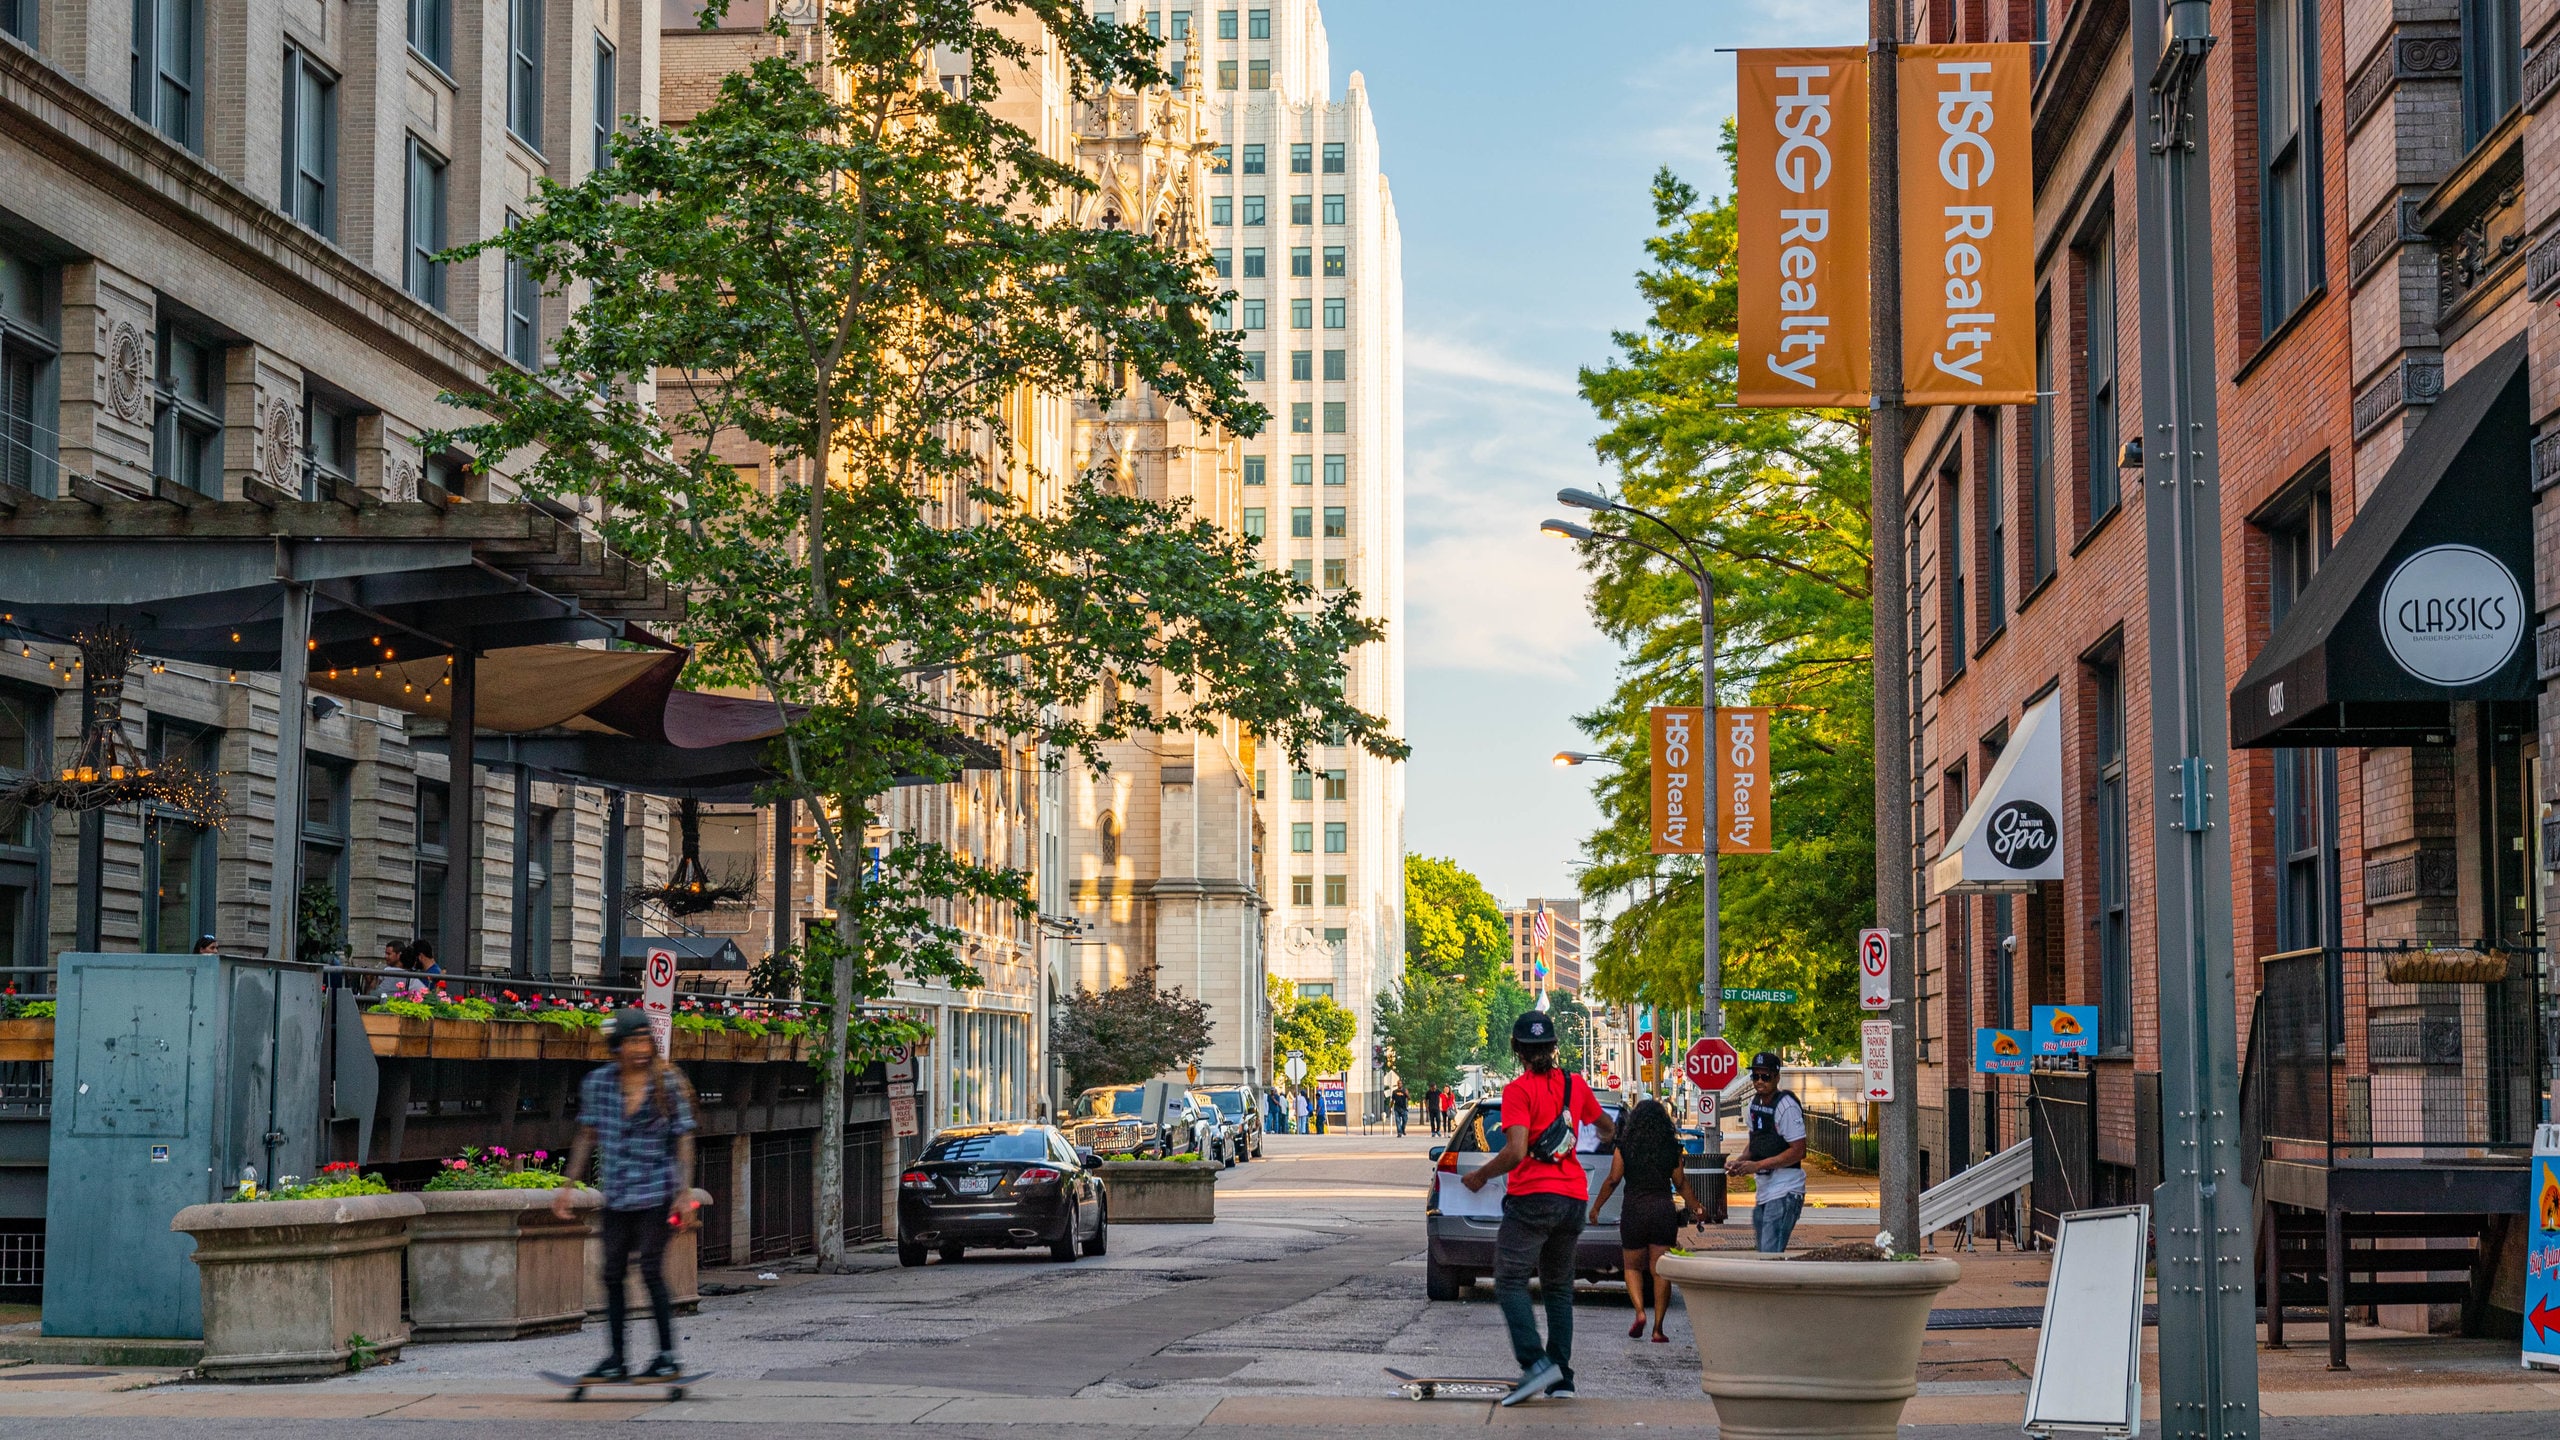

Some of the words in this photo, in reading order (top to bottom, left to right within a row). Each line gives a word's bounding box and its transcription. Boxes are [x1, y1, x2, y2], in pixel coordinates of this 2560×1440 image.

[1775, 66, 1831, 193] HSG
[1937, 62, 1994, 190] HSG
[1767, 209, 1829, 388] Realty
[1933, 206, 1995, 385] Realty
[2399, 597, 2505, 633] CLASSICS
[1665, 714, 1689, 767] HSG
[1731, 714, 1754, 767] HSG
[1663, 773, 1688, 847] Realty
[1729, 773, 1754, 846] Realty
[1994, 808, 2053, 864] Spa
[1724, 989, 1737, 999] ST
[1741, 990, 1786, 1002] CHARLES
[1863, 1025, 1890, 1035] RESTRICTED
[1867, 1036, 1887, 1046] PARKING
[2043, 1042, 2058, 1052] Big
[2060, 1038, 2088, 1049] Island
[1689, 1055, 1734, 1074] STOP
[1867, 1058, 1888, 1069] VEHICLES
[1869, 1047, 1885, 1058] POLICE
[1985, 1061, 1999, 1069] Big
[1872, 1070, 1883, 1080] ONLY
[2530, 1250, 2542, 1279] Big
